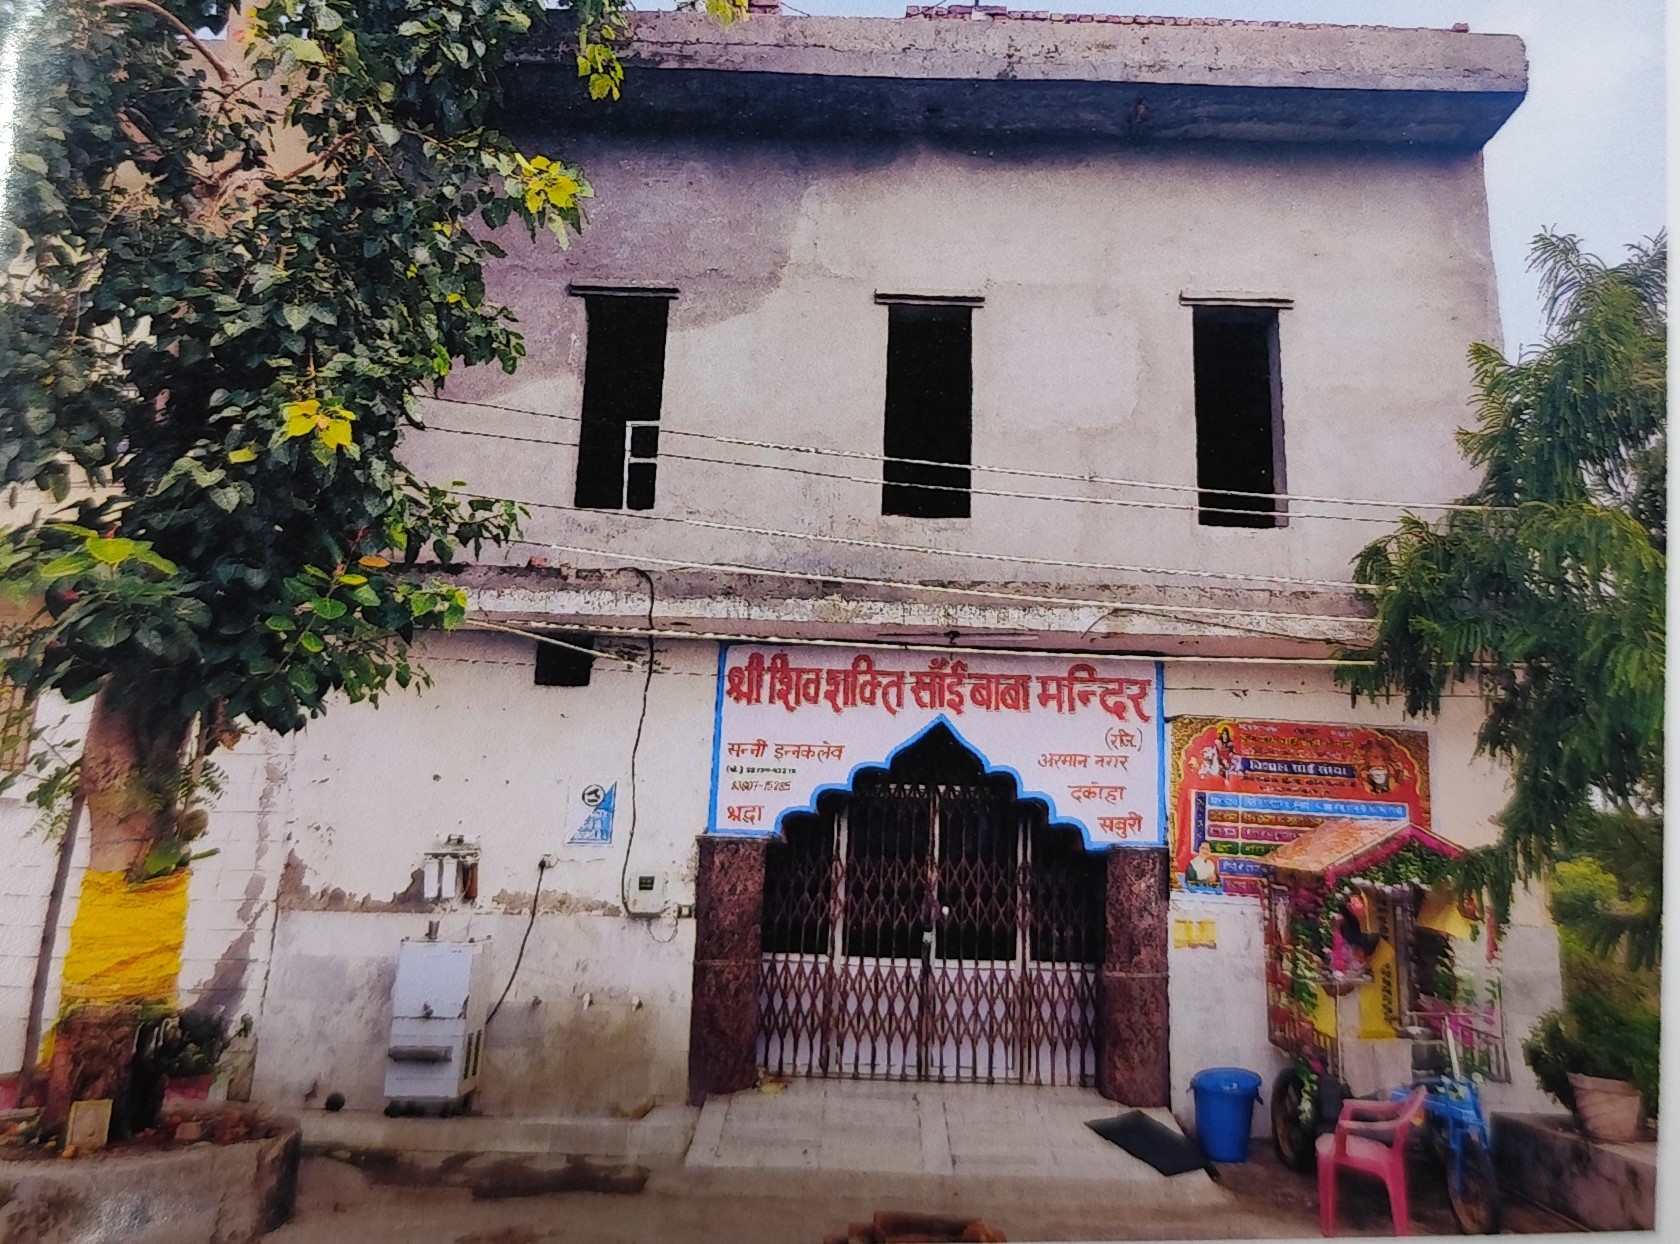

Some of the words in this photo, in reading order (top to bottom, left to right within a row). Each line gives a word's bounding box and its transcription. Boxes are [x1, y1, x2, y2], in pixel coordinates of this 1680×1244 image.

[726, 652, 765, 706] श्री
[767, 653, 823, 712] शिव
[824, 654, 905, 716] शक्ति
[968, 673, 1031, 712] बाबा
[1036, 663, 1152, 722] मन्दिर
[727, 739, 768, 757] सन्नी
[1037, 753, 1091, 769] अरमान
[1094, 755, 1129, 772] नगर
